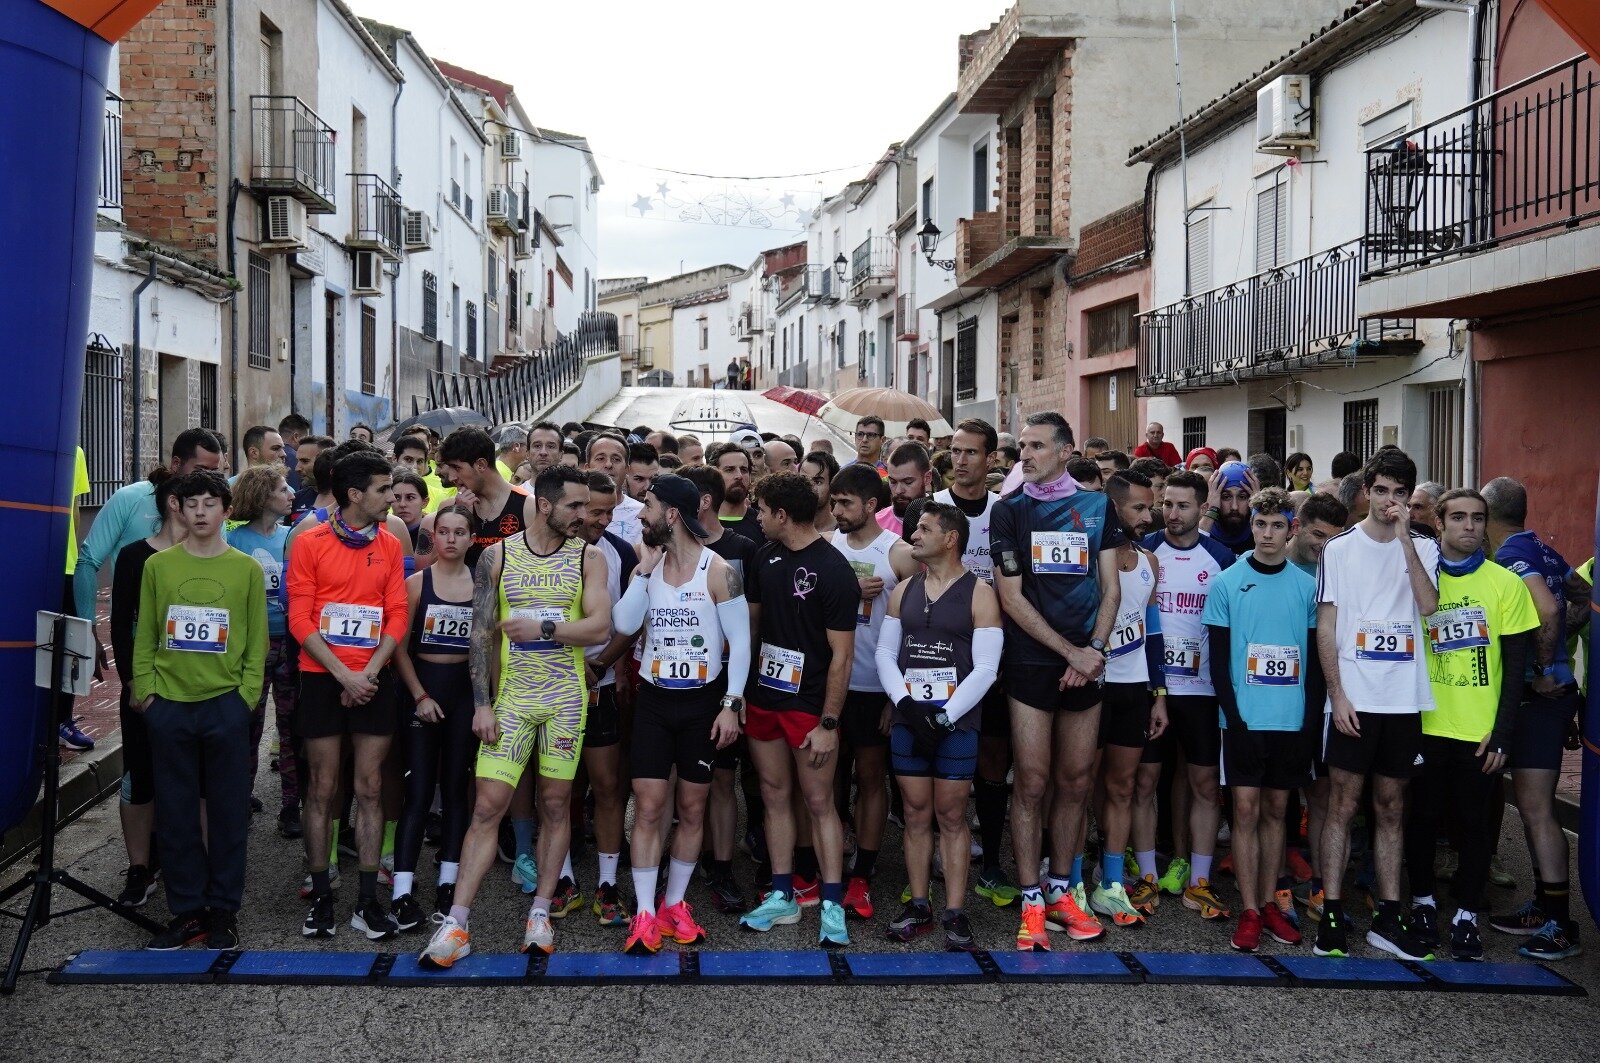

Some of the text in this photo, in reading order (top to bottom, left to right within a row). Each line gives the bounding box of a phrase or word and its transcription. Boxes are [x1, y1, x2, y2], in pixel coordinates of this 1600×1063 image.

[1051, 546, 1072, 564] 61
[520, 573, 563, 588] RAFITA
[1177, 592, 1208, 609] QUIJO
[650, 607, 690, 618] TIERRAS
[340, 619, 362, 637] 17
[436, 619, 470, 637] 126
[650, 616, 700, 628] CANENA
[184, 622, 210, 641] 96
[1116, 626, 1135, 646] 70
[1441, 621, 1474, 641] 157
[1374, 635, 1398, 652] 29
[1164, 650, 1187, 667] 84
[669, 661, 690, 679] 10
[765, 660, 785, 679] 57
[1265, 660, 1287, 677] 89
[922, 683, 934, 700] 3
